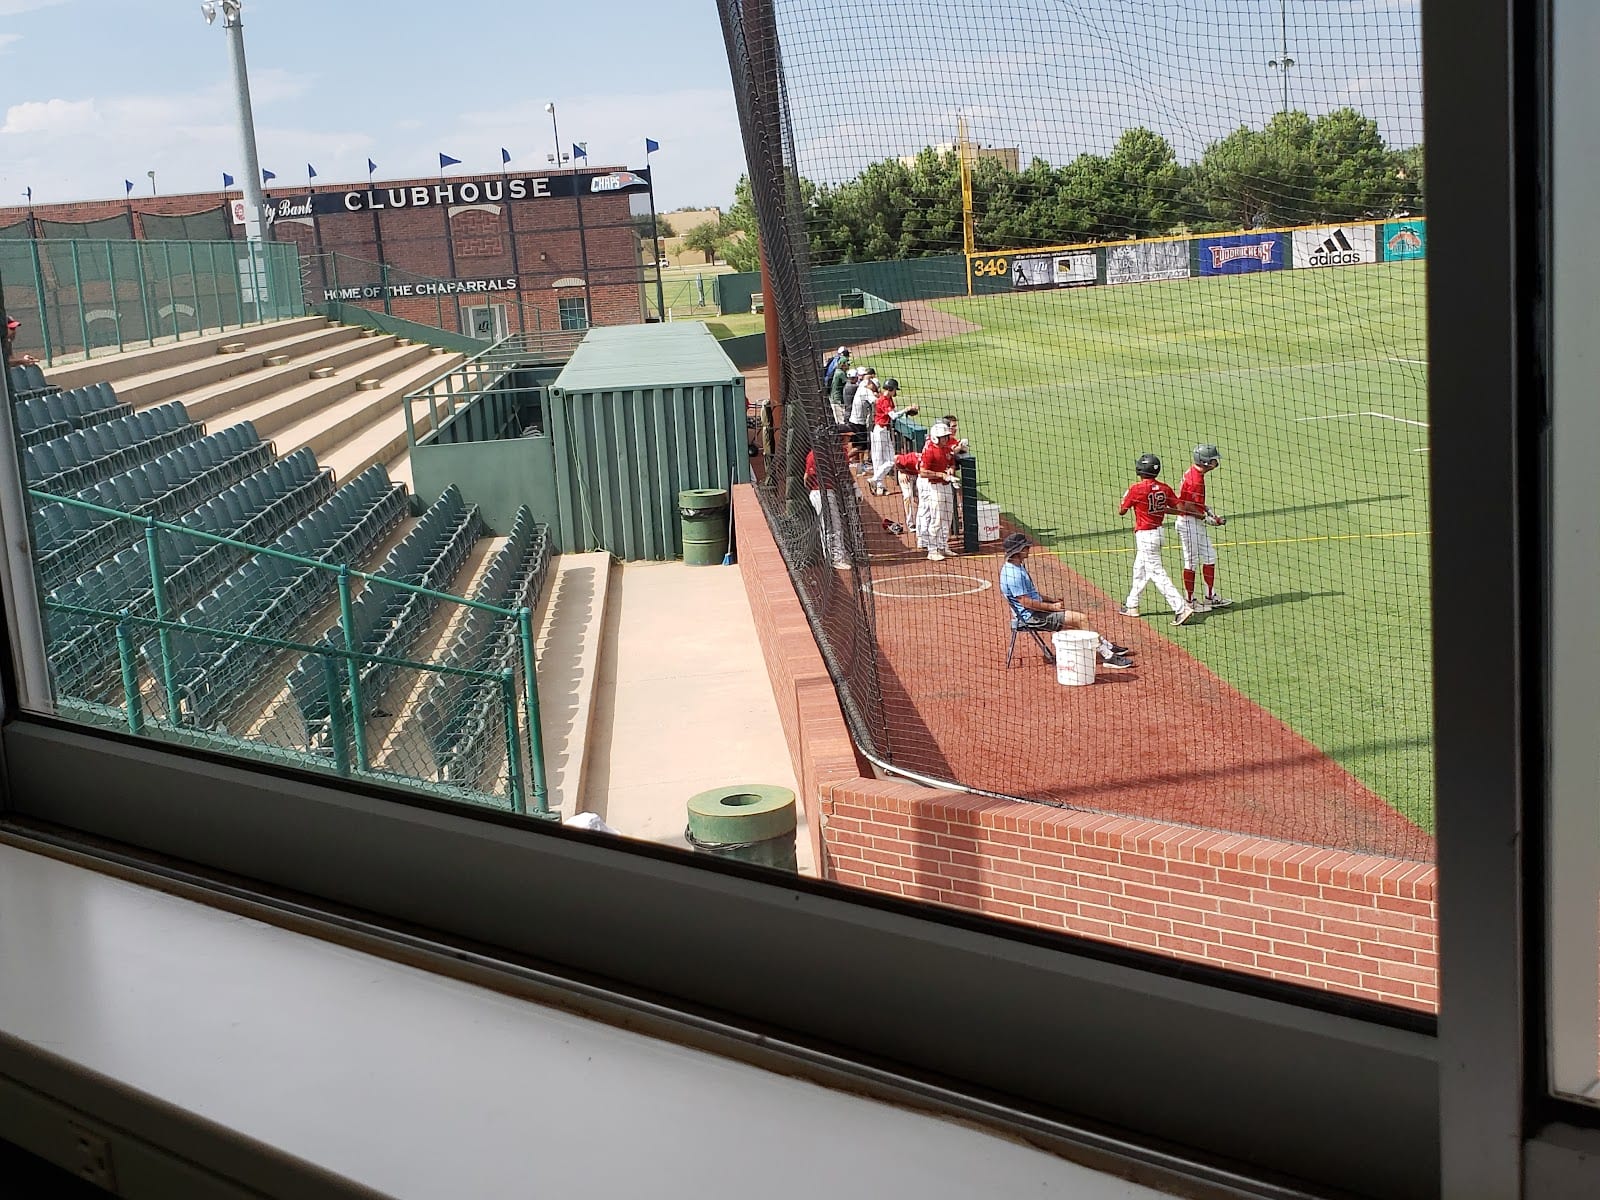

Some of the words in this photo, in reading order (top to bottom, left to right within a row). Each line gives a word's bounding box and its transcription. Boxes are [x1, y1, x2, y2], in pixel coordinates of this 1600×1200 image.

[343, 177, 551, 212] CLUBHOUSE
[590, 175, 620, 193] CHAPS
[278, 196, 313, 217] Bank
[974, 257, 1008, 277] 340
[1308, 252, 1360, 266] adidas
[324, 287, 361, 300] HOME
[363, 286, 380, 298] OF
[386, 285, 412, 298] THE
[415, 278, 517, 295] CHAPARRALS
[1147, 491, 1167, 514] 12
